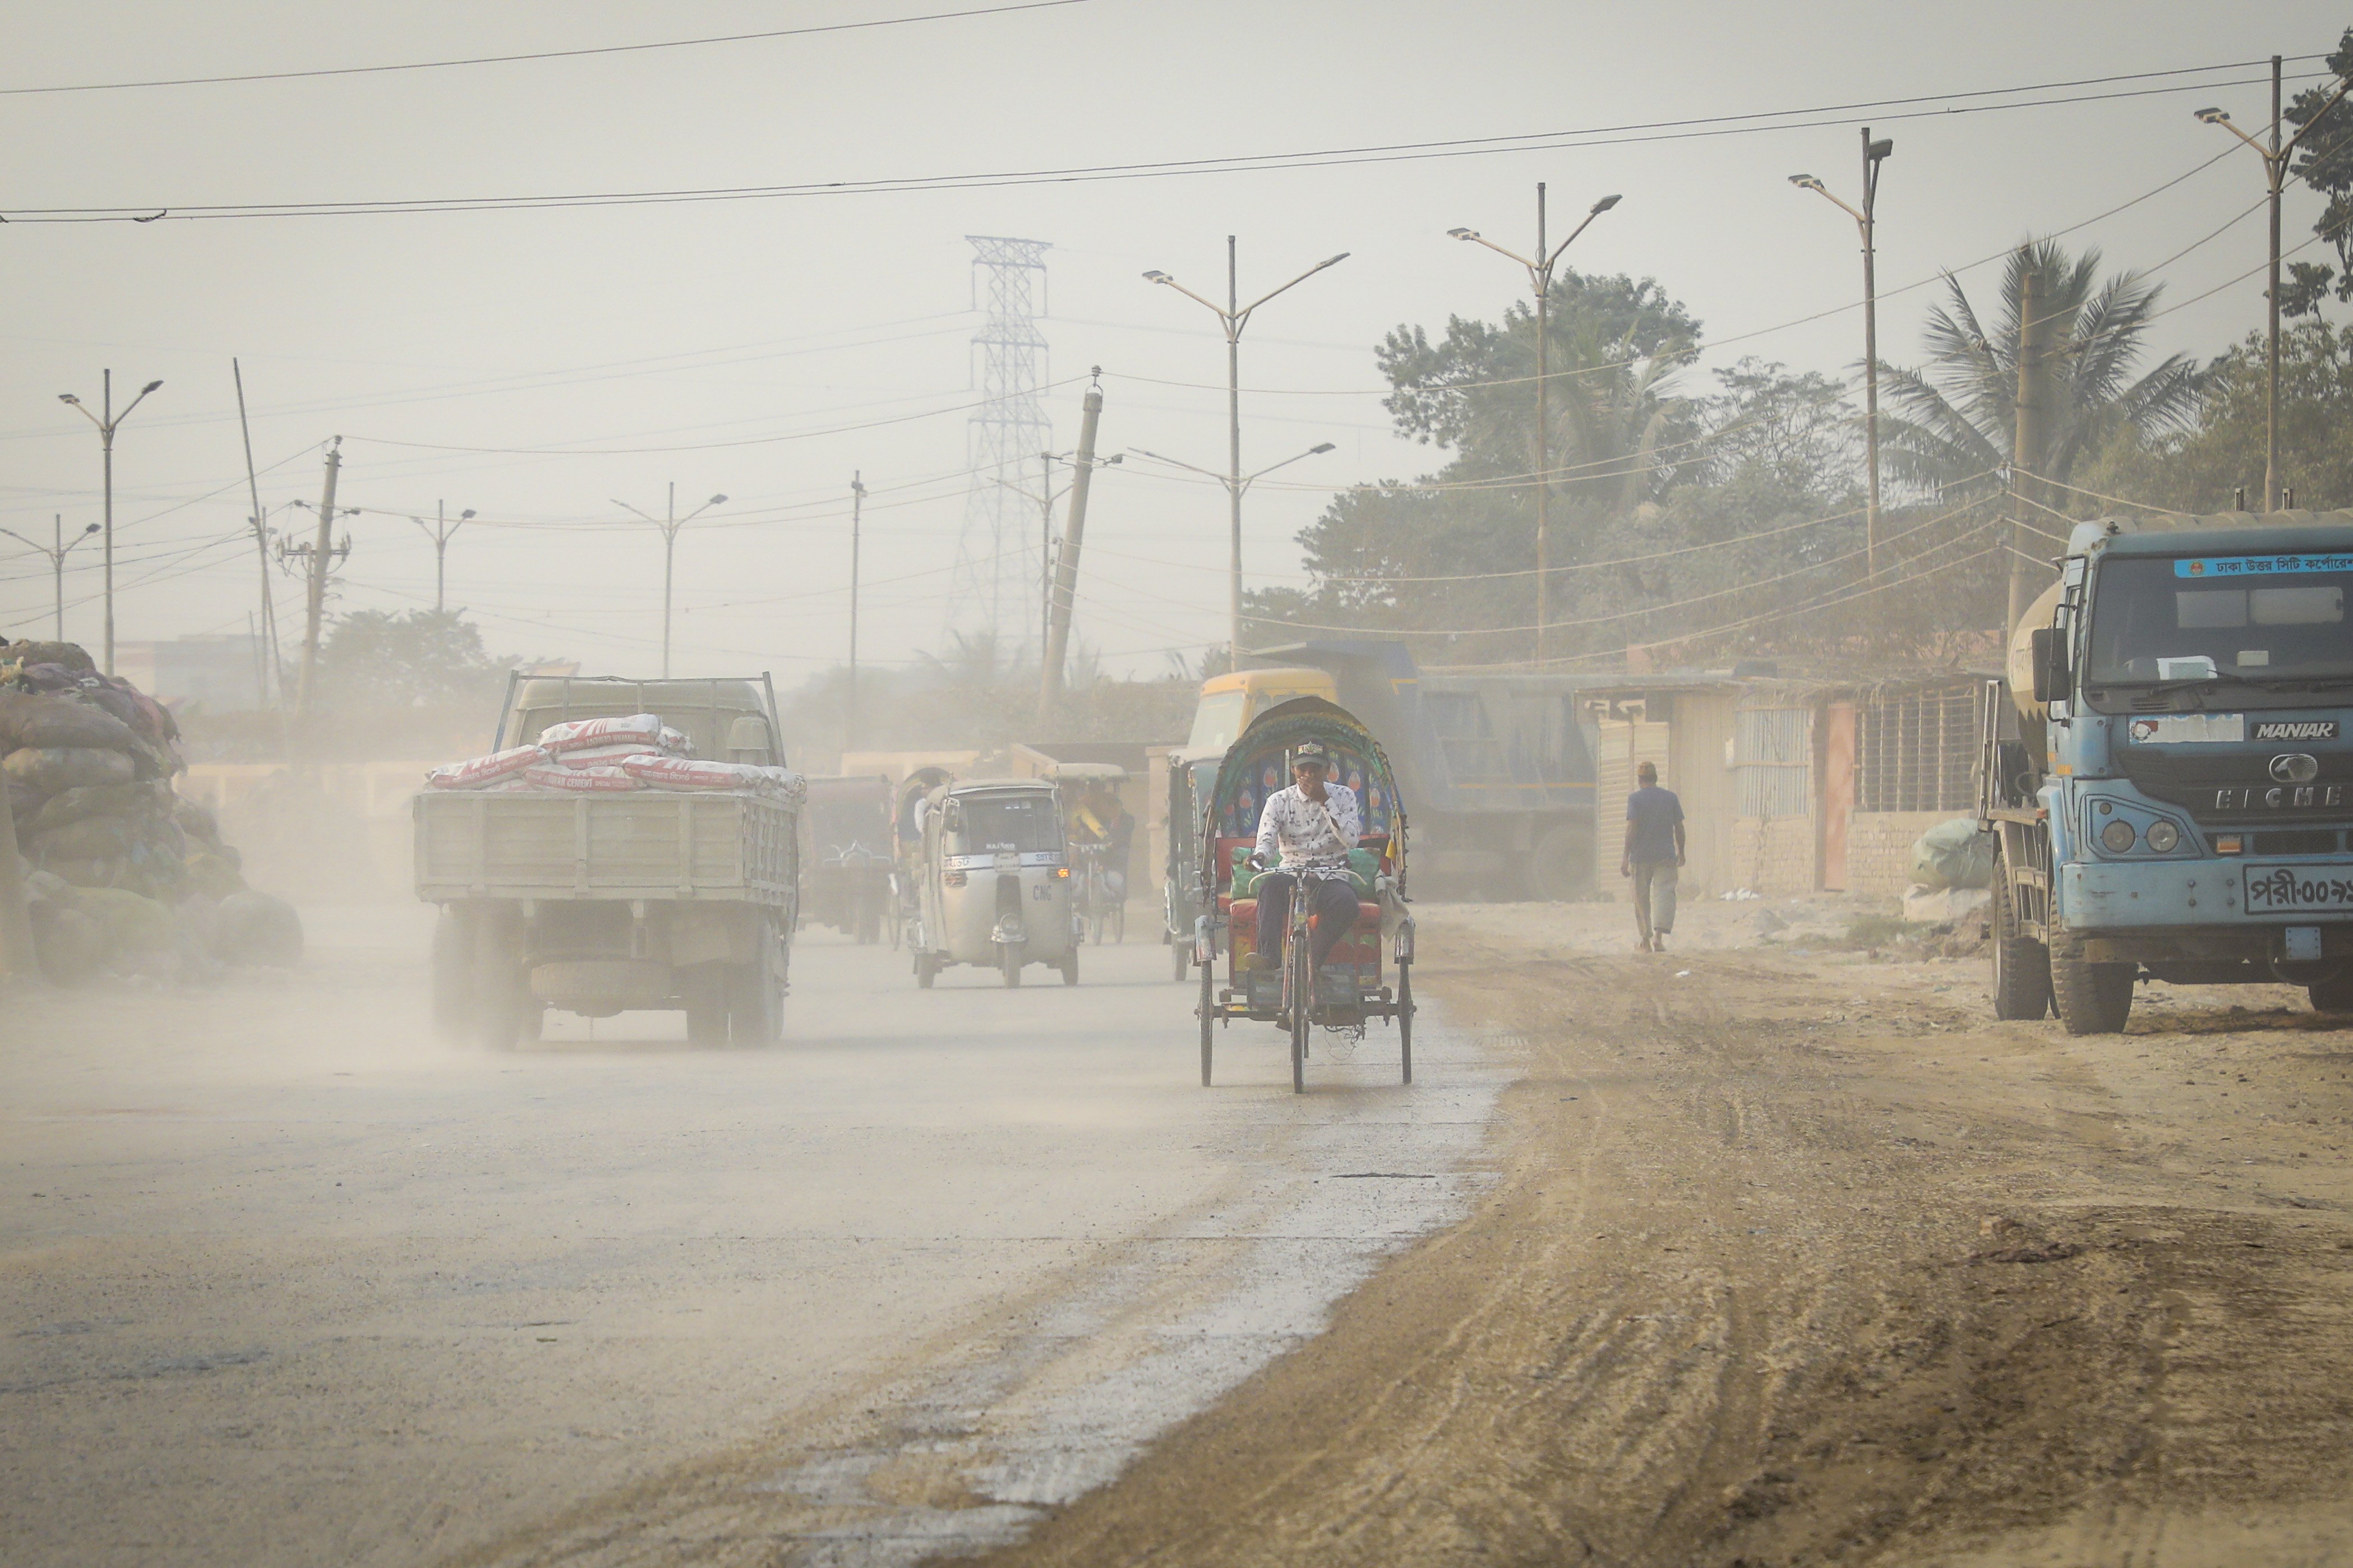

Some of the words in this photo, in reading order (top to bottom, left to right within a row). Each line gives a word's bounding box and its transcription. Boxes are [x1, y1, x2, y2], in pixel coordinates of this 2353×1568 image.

[2217, 562, 2241, 572] ঢাকা
[2245, 559, 2272, 571] উত্তর
[2277, 557, 2300, 569] সিটি
[2257, 722, 2334, 738] MANIAR
